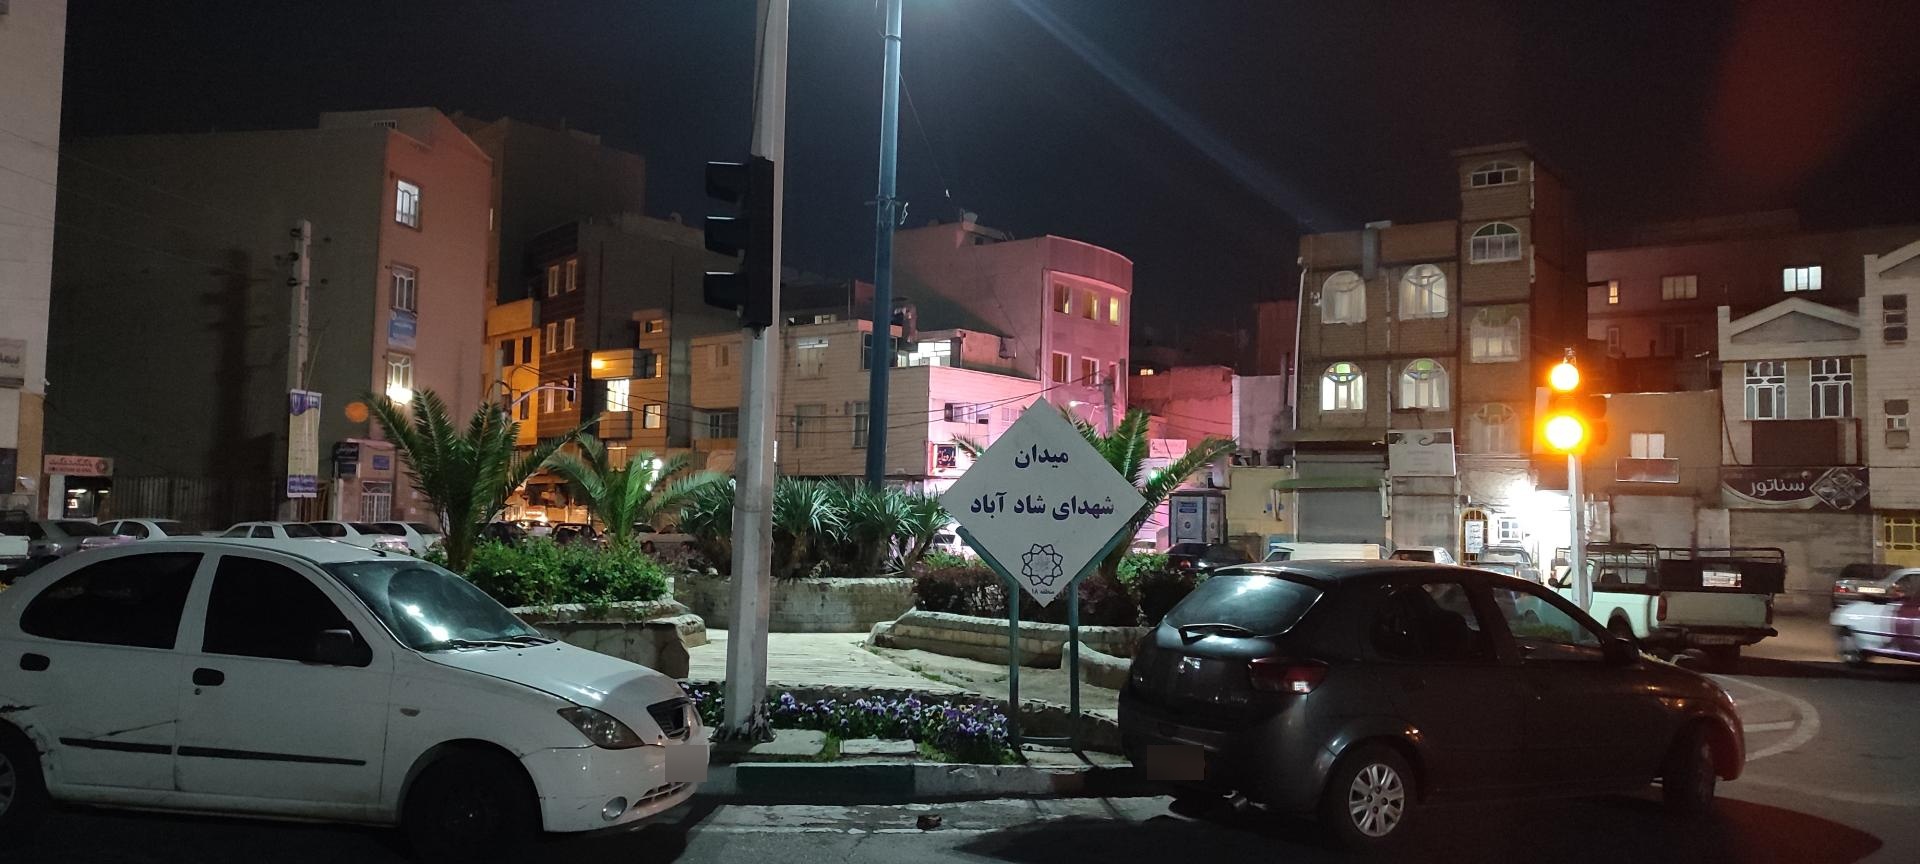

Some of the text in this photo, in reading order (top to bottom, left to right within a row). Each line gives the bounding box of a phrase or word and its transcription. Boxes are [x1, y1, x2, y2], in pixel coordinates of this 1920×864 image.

[1014, 444, 1069, 468] میدان
[1750, 478, 1805, 497] سناتور
[970, 491, 1114, 521] شهدای شاد آباد
